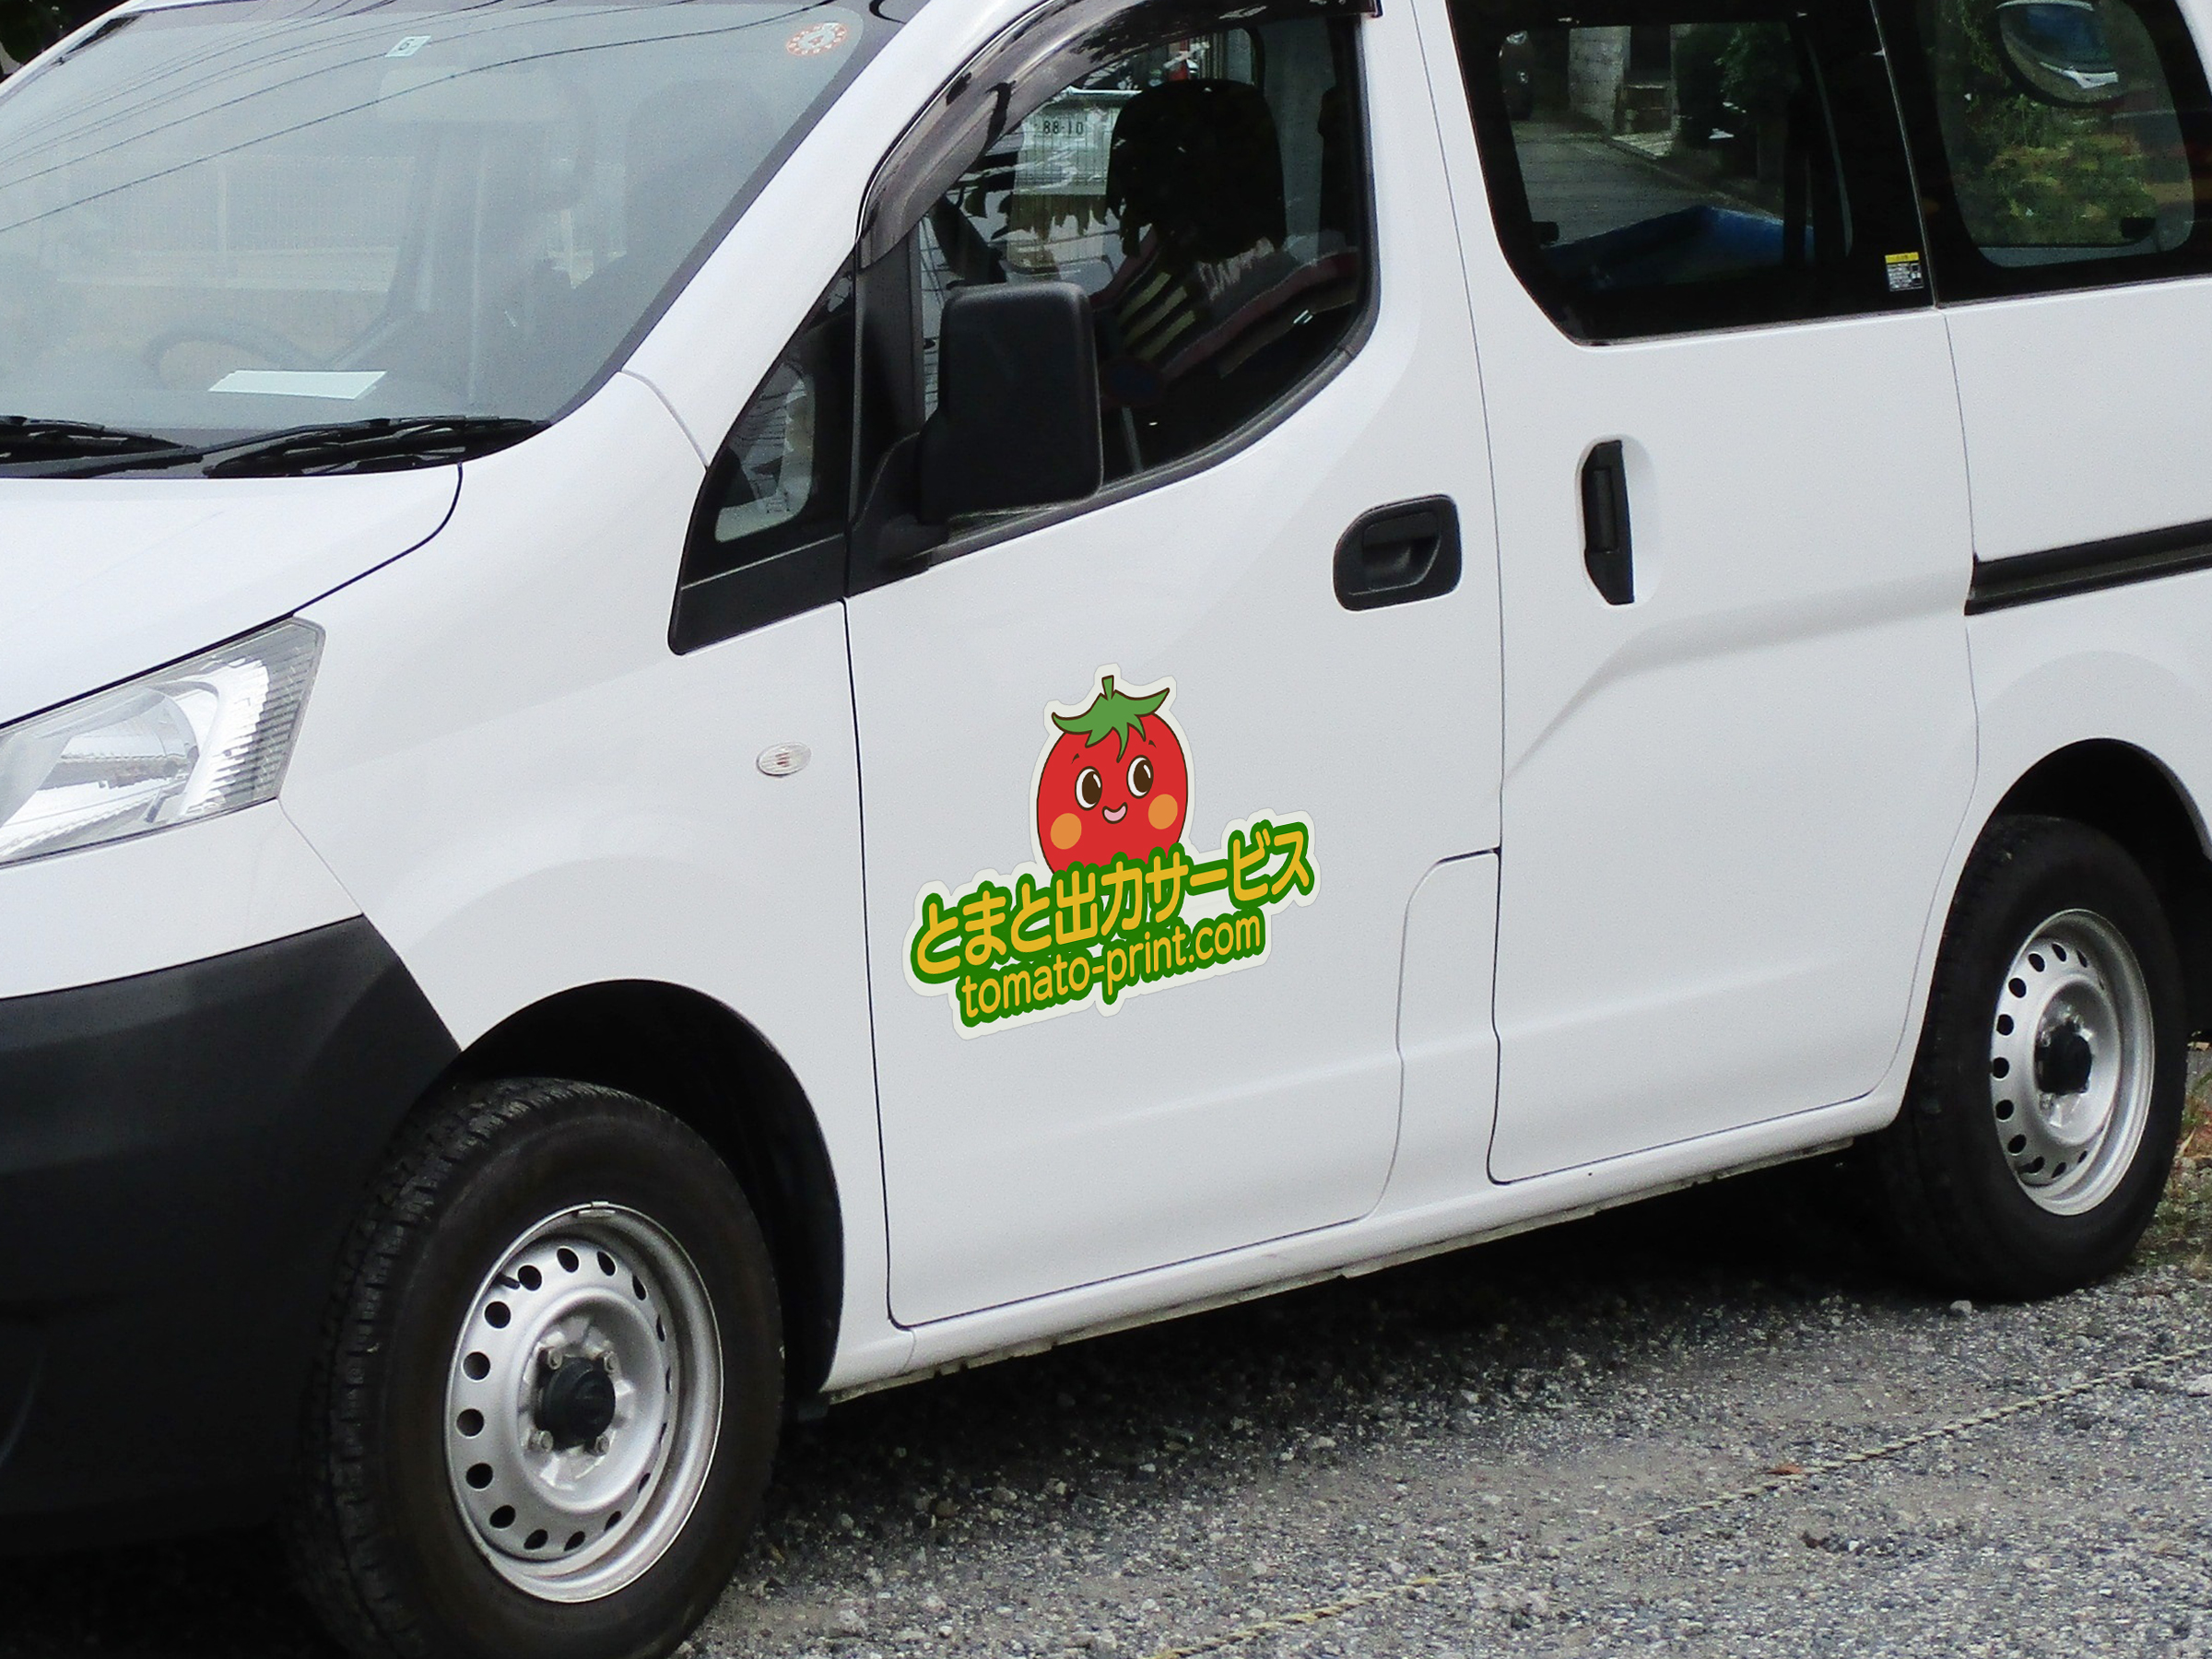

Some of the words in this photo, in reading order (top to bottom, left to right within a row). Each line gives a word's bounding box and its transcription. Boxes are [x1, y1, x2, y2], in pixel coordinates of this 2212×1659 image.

[916, 827, 1311, 975] とまと出力サービス
[960, 914, 1262, 1018] tomato-print.com
